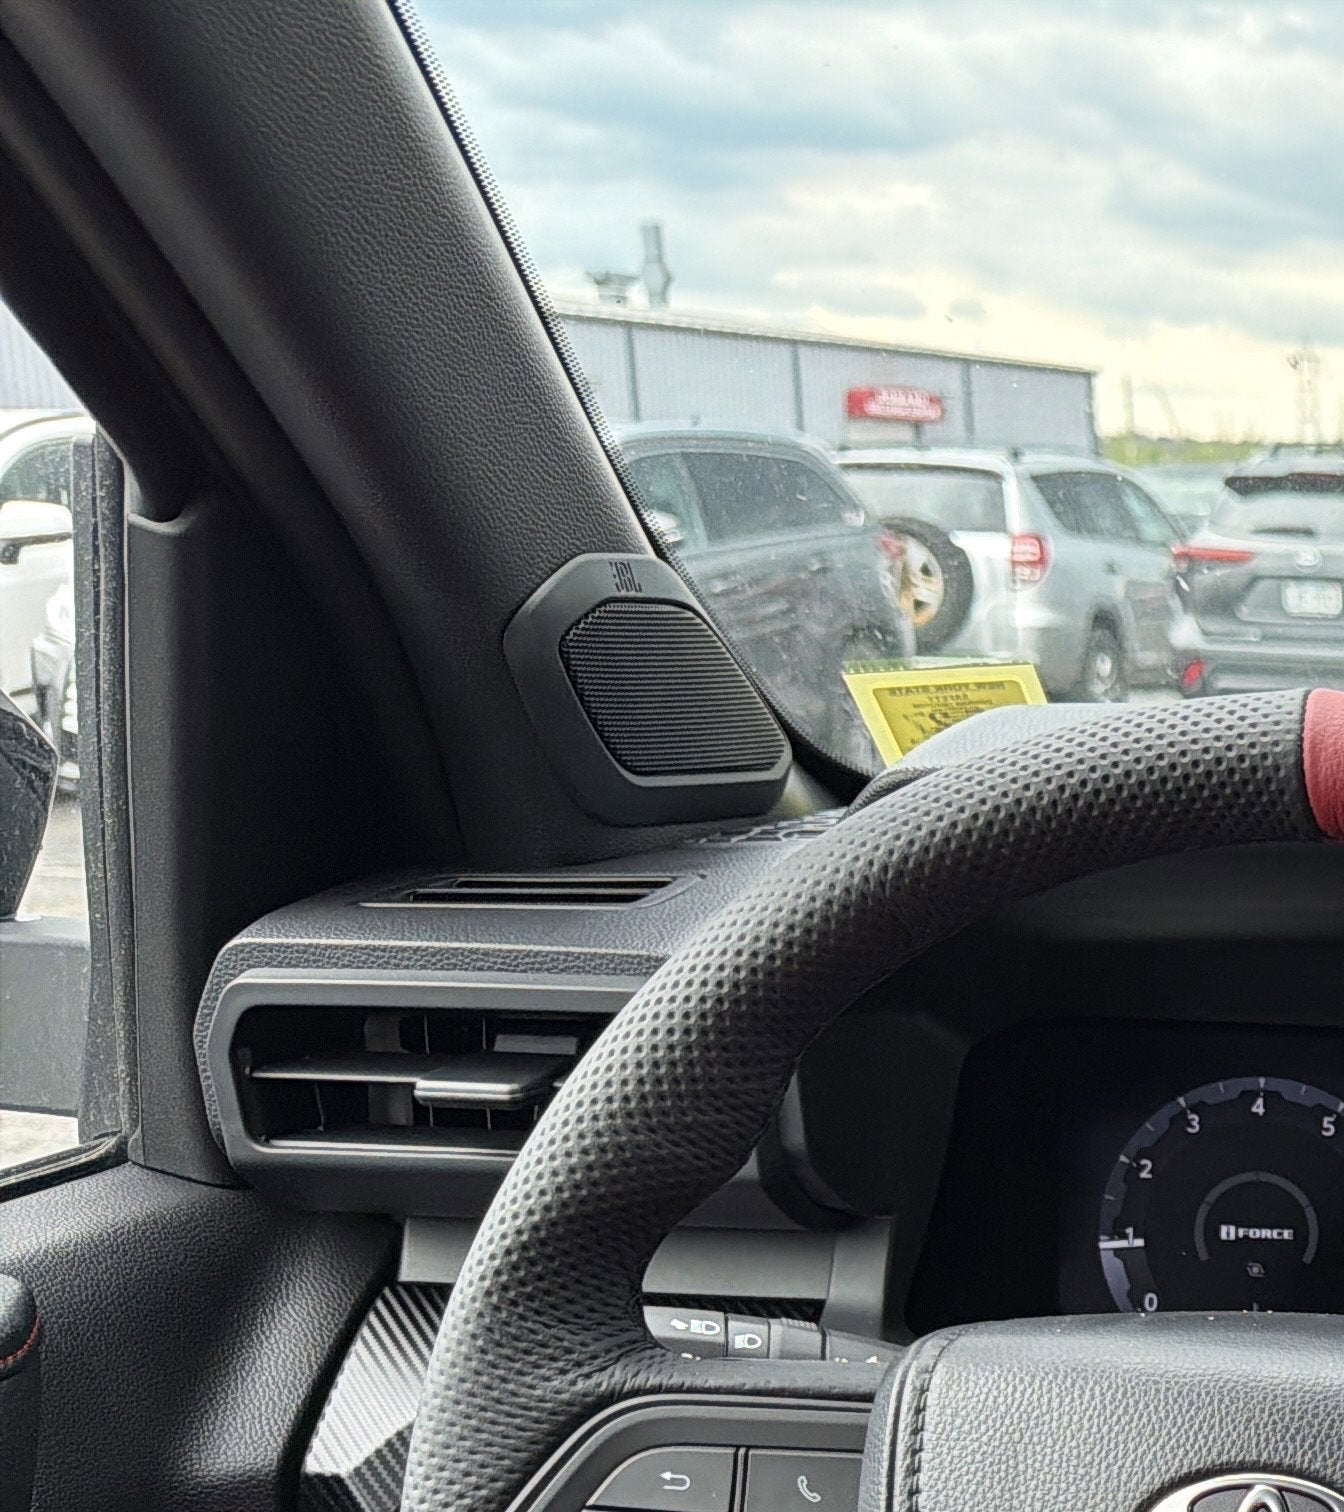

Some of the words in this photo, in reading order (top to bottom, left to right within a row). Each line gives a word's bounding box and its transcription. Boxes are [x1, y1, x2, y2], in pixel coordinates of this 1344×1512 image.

[609, 561, 643, 593] JBL
[1251, 1097, 1266, 1116] 4
[1186, 1114, 1200, 1134] 3
[1321, 1116, 1336, 1136] 5
[1139, 1160, 1153, 1179] 2
[1143, 1293, 1158, 1312] 0
